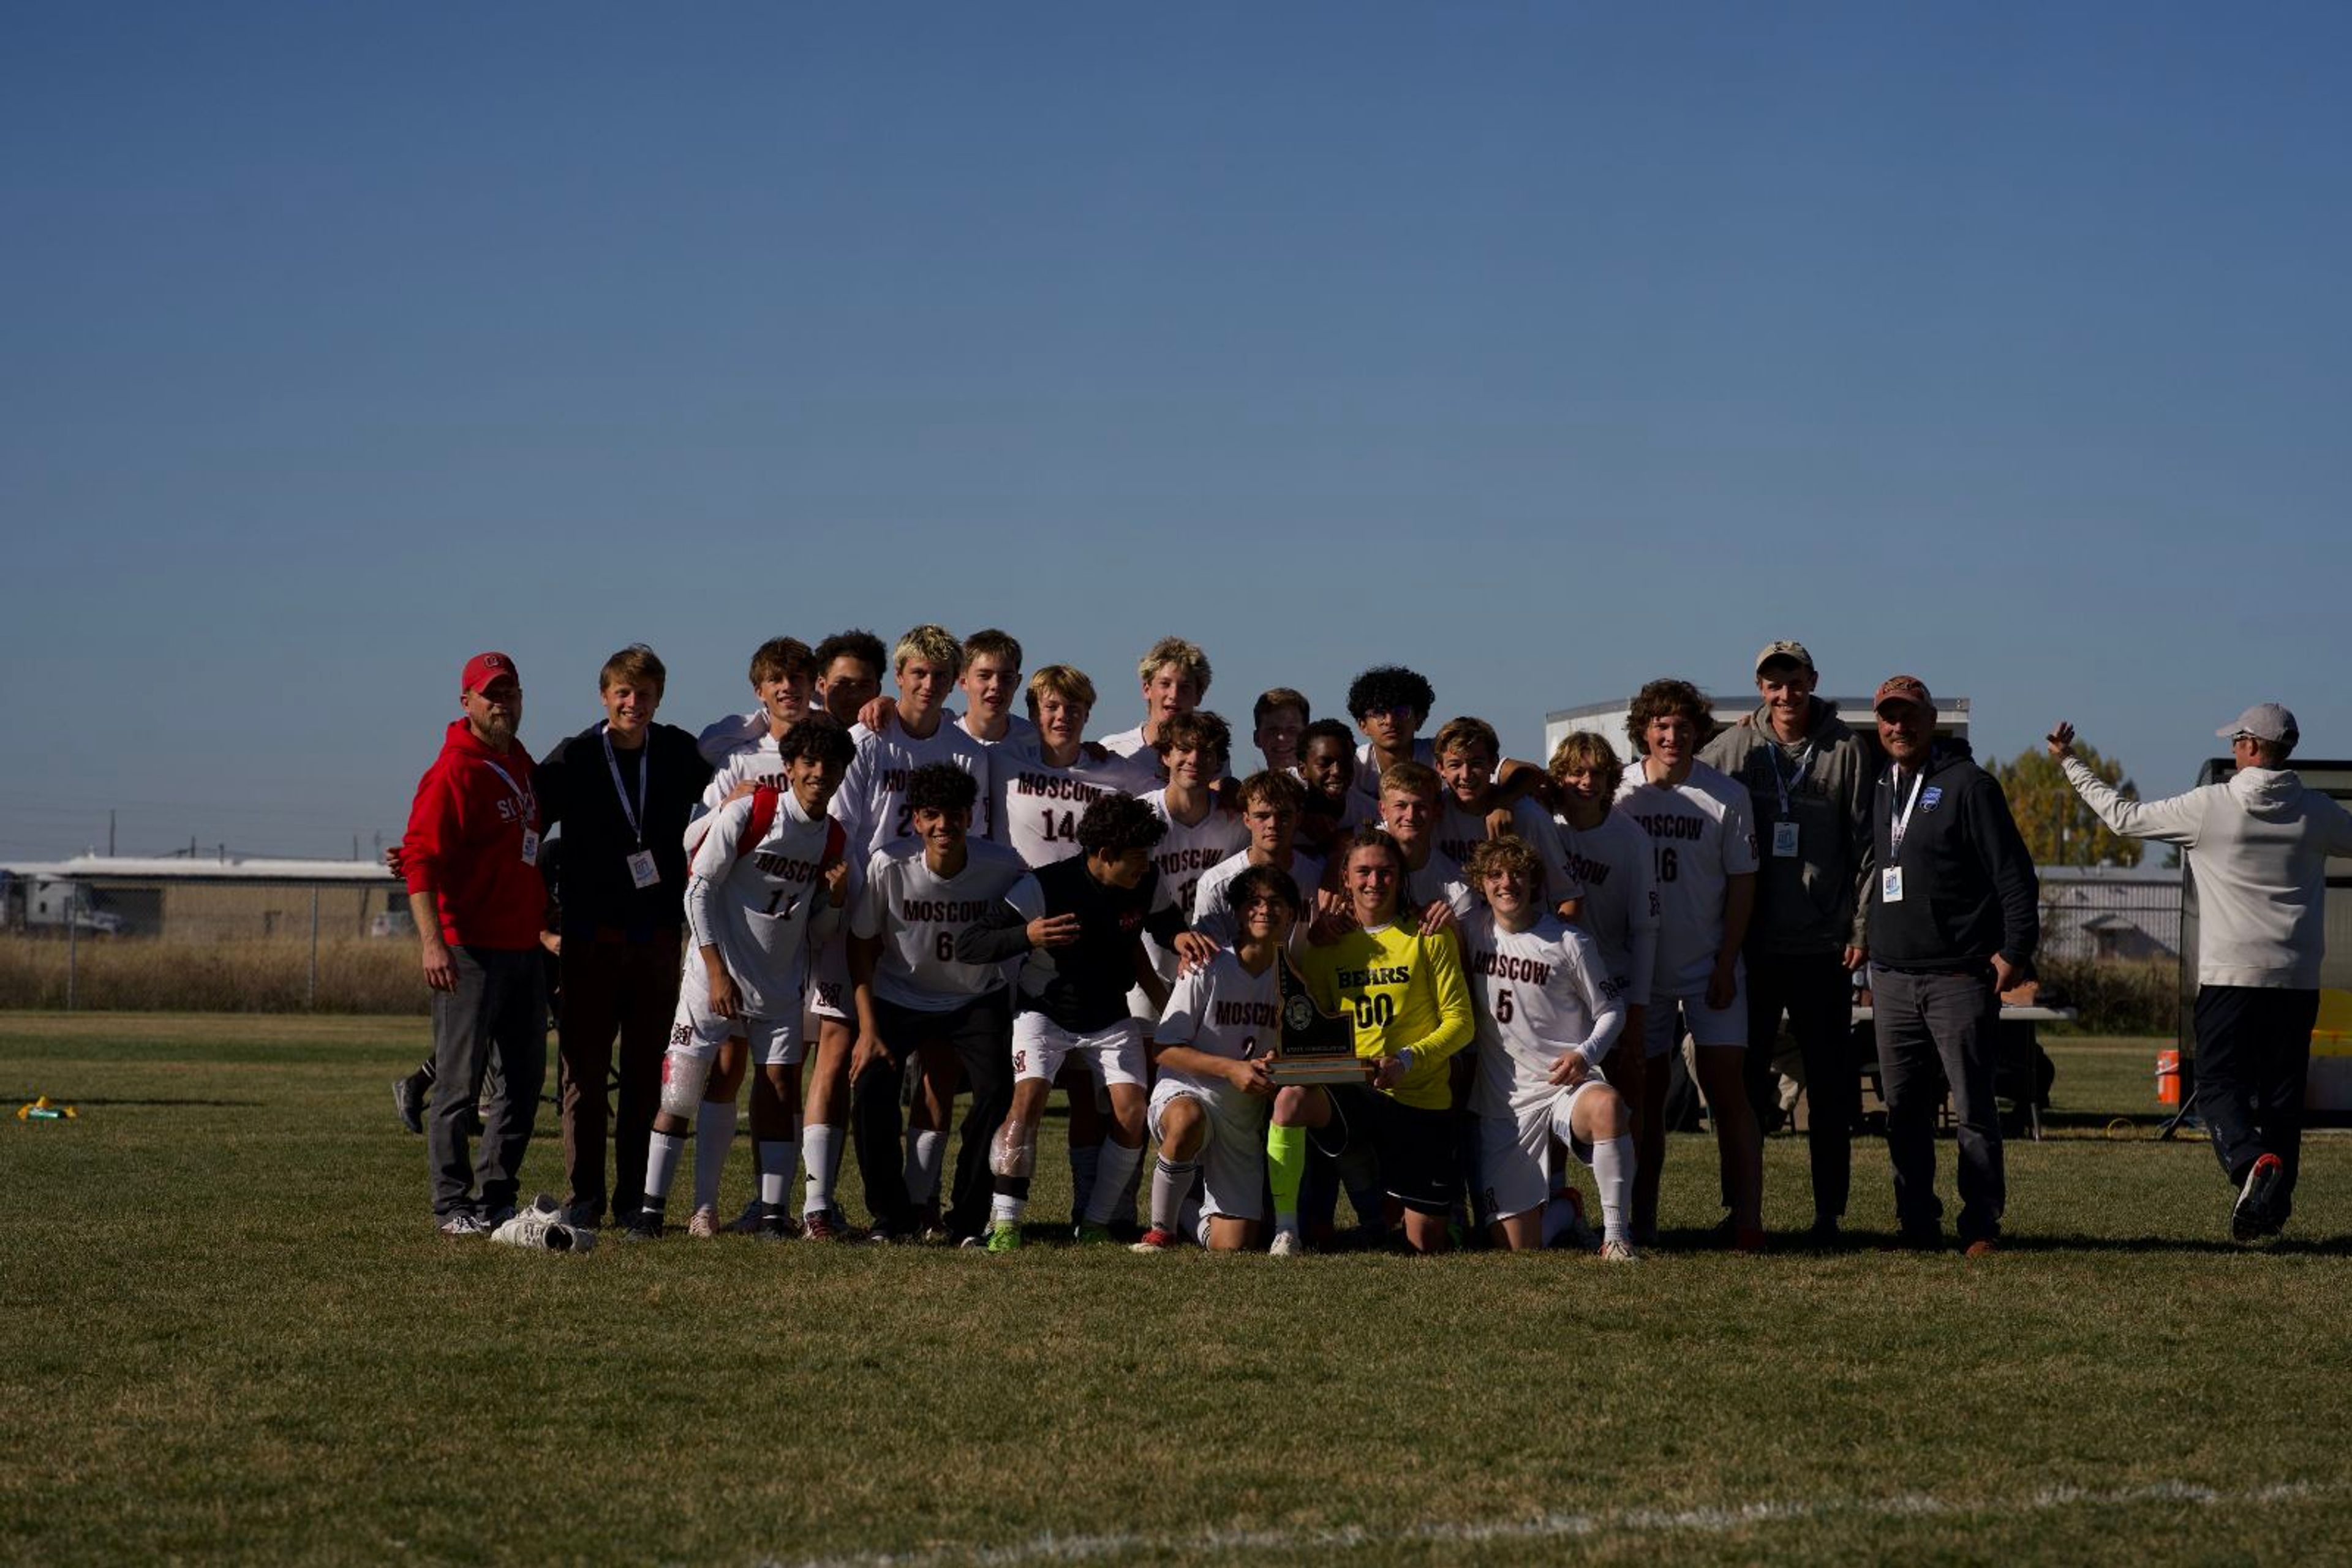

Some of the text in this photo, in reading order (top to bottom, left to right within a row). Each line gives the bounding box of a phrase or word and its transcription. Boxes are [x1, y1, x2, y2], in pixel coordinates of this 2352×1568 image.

[1019, 772, 1101, 802] MOSCOW
[1042, 809, 1074, 842] 14
[1634, 815, 1703, 839] OSCOW
[764, 889, 799, 920] 11
[903, 900, 989, 922] MOSCOW
[937, 932, 953, 960] 6
[1474, 951, 1550, 986] MOSCOW
[1355, 992, 1393, 1028] 00
[1497, 989, 1513, 1023] 5
